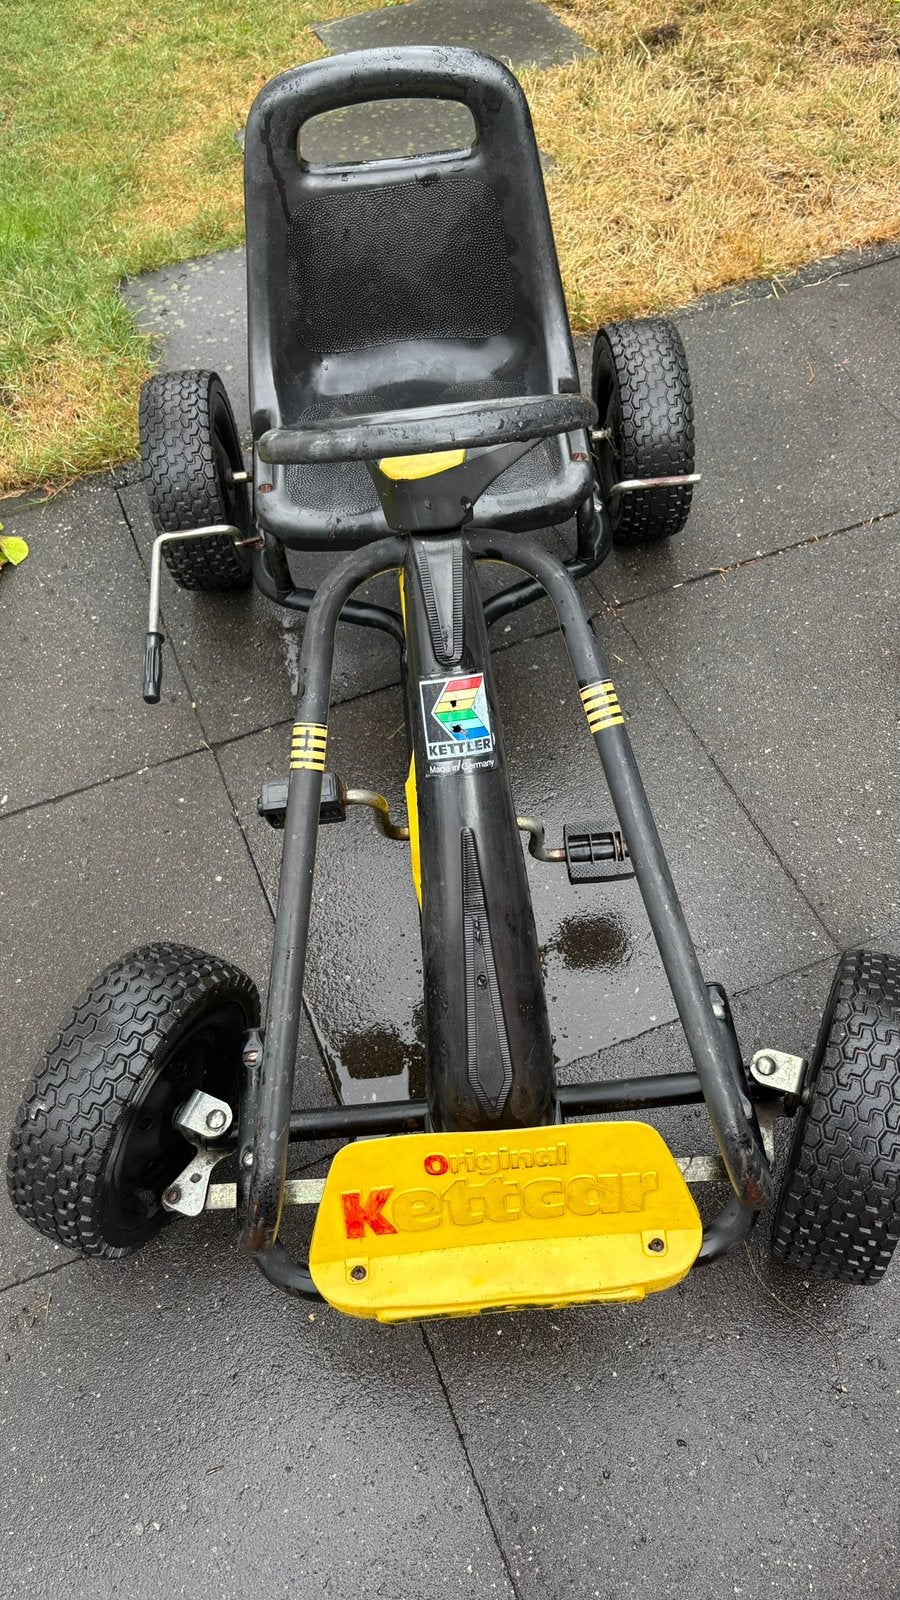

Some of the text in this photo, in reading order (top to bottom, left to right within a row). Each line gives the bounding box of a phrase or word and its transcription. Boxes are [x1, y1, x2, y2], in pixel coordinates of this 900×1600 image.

[428, 738, 491, 756] KETTLER
[429, 759, 495, 774] Made in Germany
[340, 1170, 658, 1239] Kettcar
